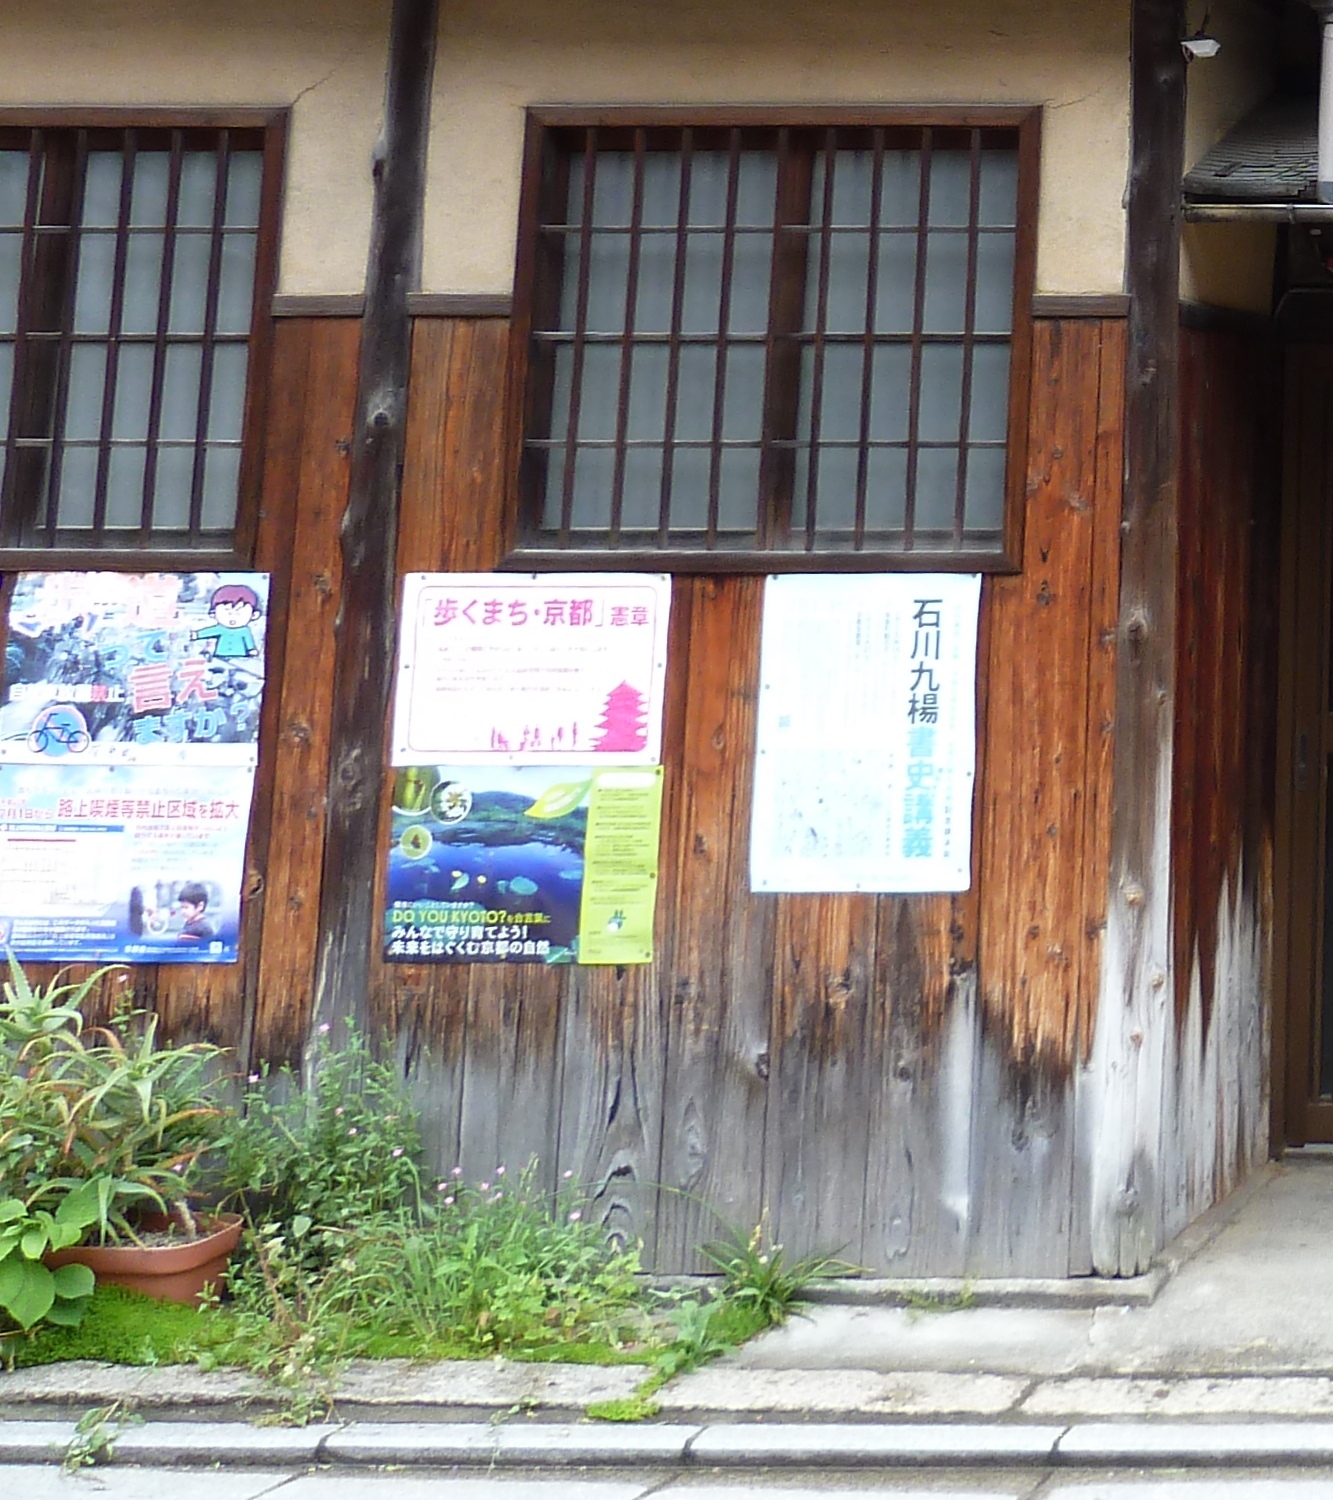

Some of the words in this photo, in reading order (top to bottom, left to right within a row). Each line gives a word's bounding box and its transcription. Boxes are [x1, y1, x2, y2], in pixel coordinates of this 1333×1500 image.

[129, 659, 219, 713] 言え
[392, 910, 415, 923] DO
[419, 910, 448, 923] YOU
